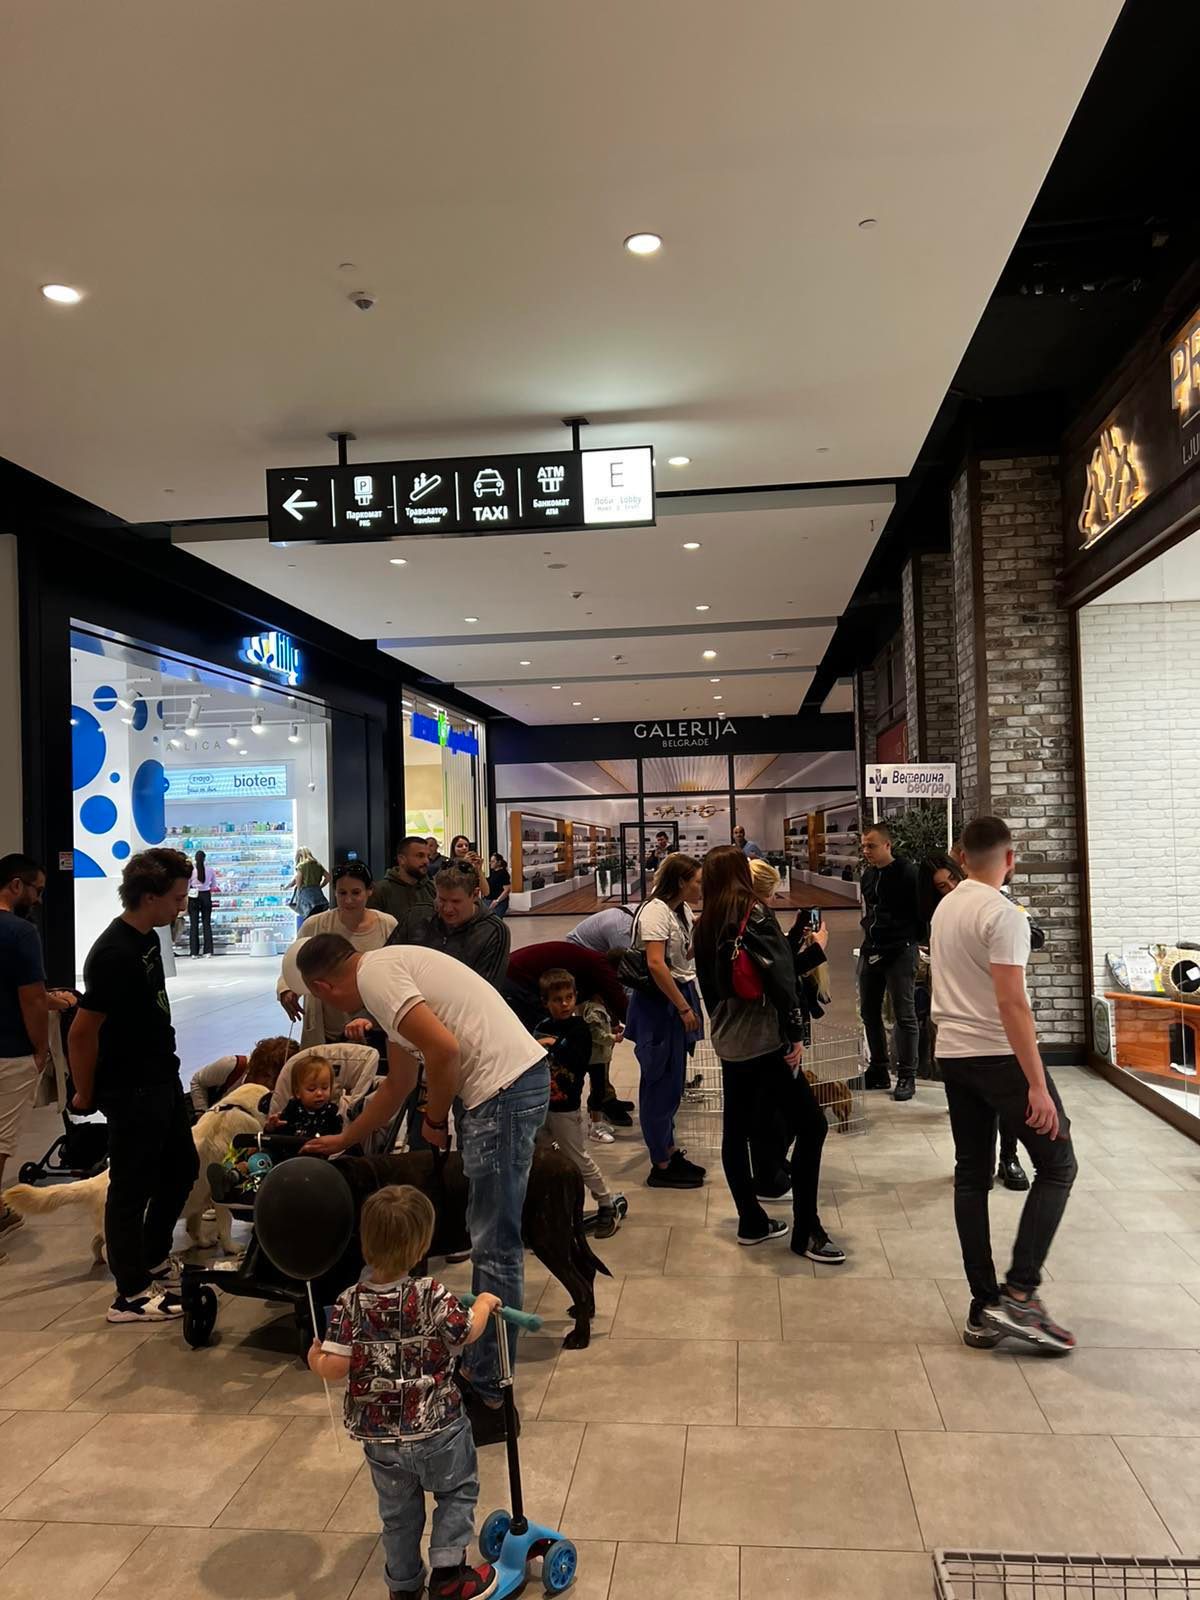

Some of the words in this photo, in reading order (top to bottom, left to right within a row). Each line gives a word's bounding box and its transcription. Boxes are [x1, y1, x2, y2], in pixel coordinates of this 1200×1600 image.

[537, 465, 565, 479] ATM
[609, 461, 624, 488] E
[533, 498, 570, 508] Банкомат
[346, 510, 383, 521] Паркомат
[405, 507, 448, 518] Травелатор
[472, 505, 508, 522] TAXI
[634, 720, 737, 740] GALERIJA
[662, 738, 710, 748] BELGRADE
[233, 773, 276, 788] bioten
